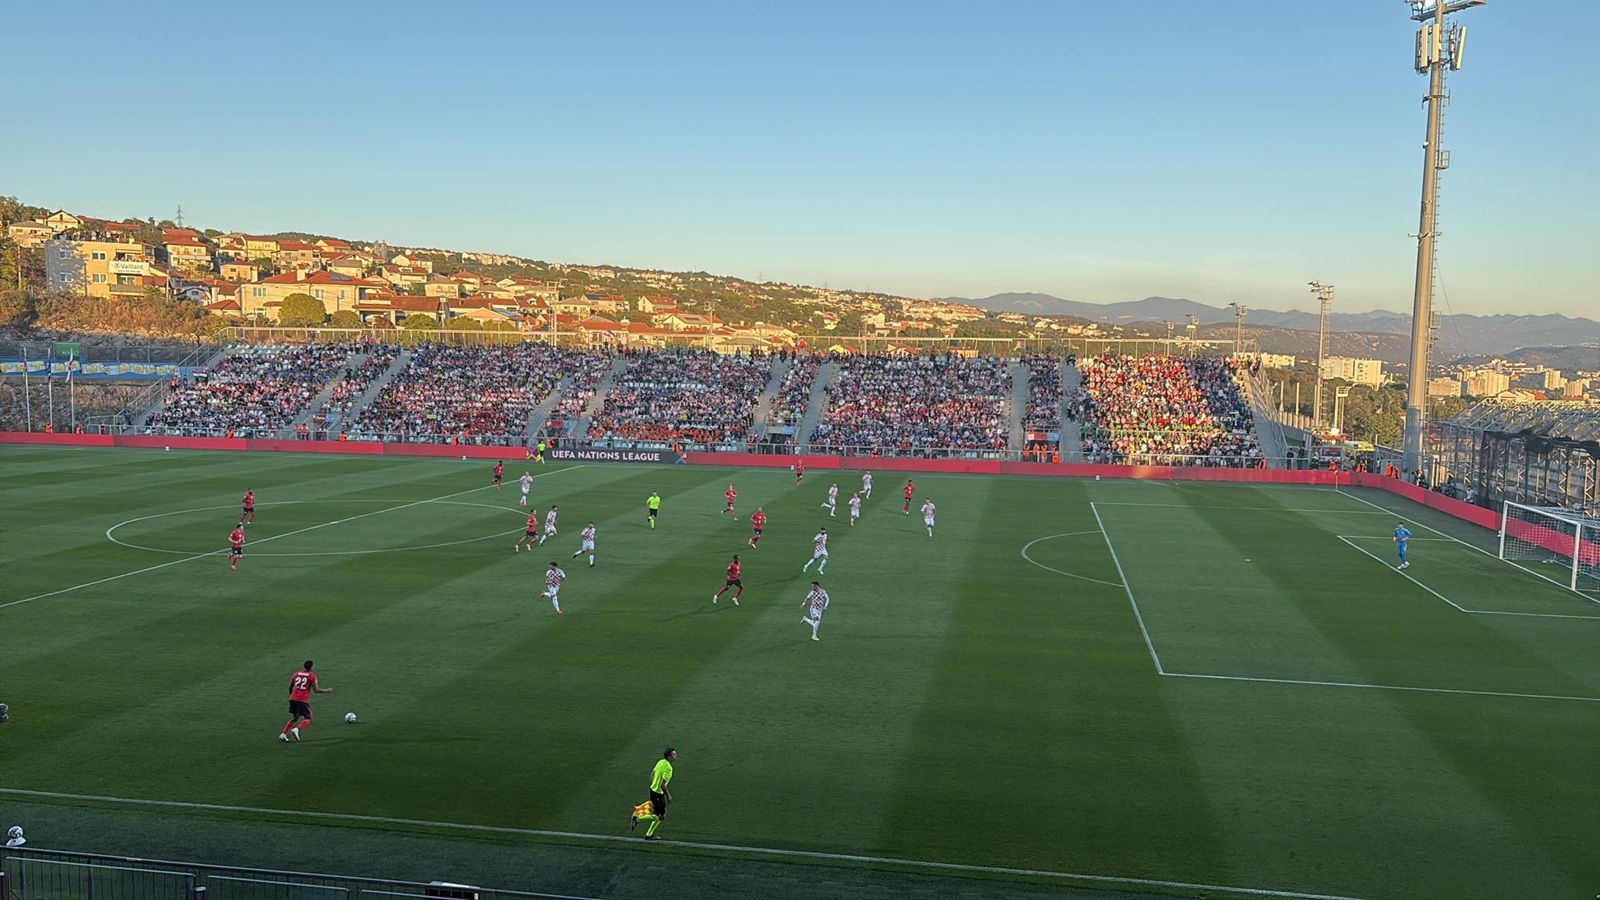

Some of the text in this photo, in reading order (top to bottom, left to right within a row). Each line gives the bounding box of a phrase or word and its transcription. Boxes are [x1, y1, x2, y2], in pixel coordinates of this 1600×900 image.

[552, 450, 660, 461] UEFA NATIONS LEAGUE
[295, 676, 308, 690] 22
